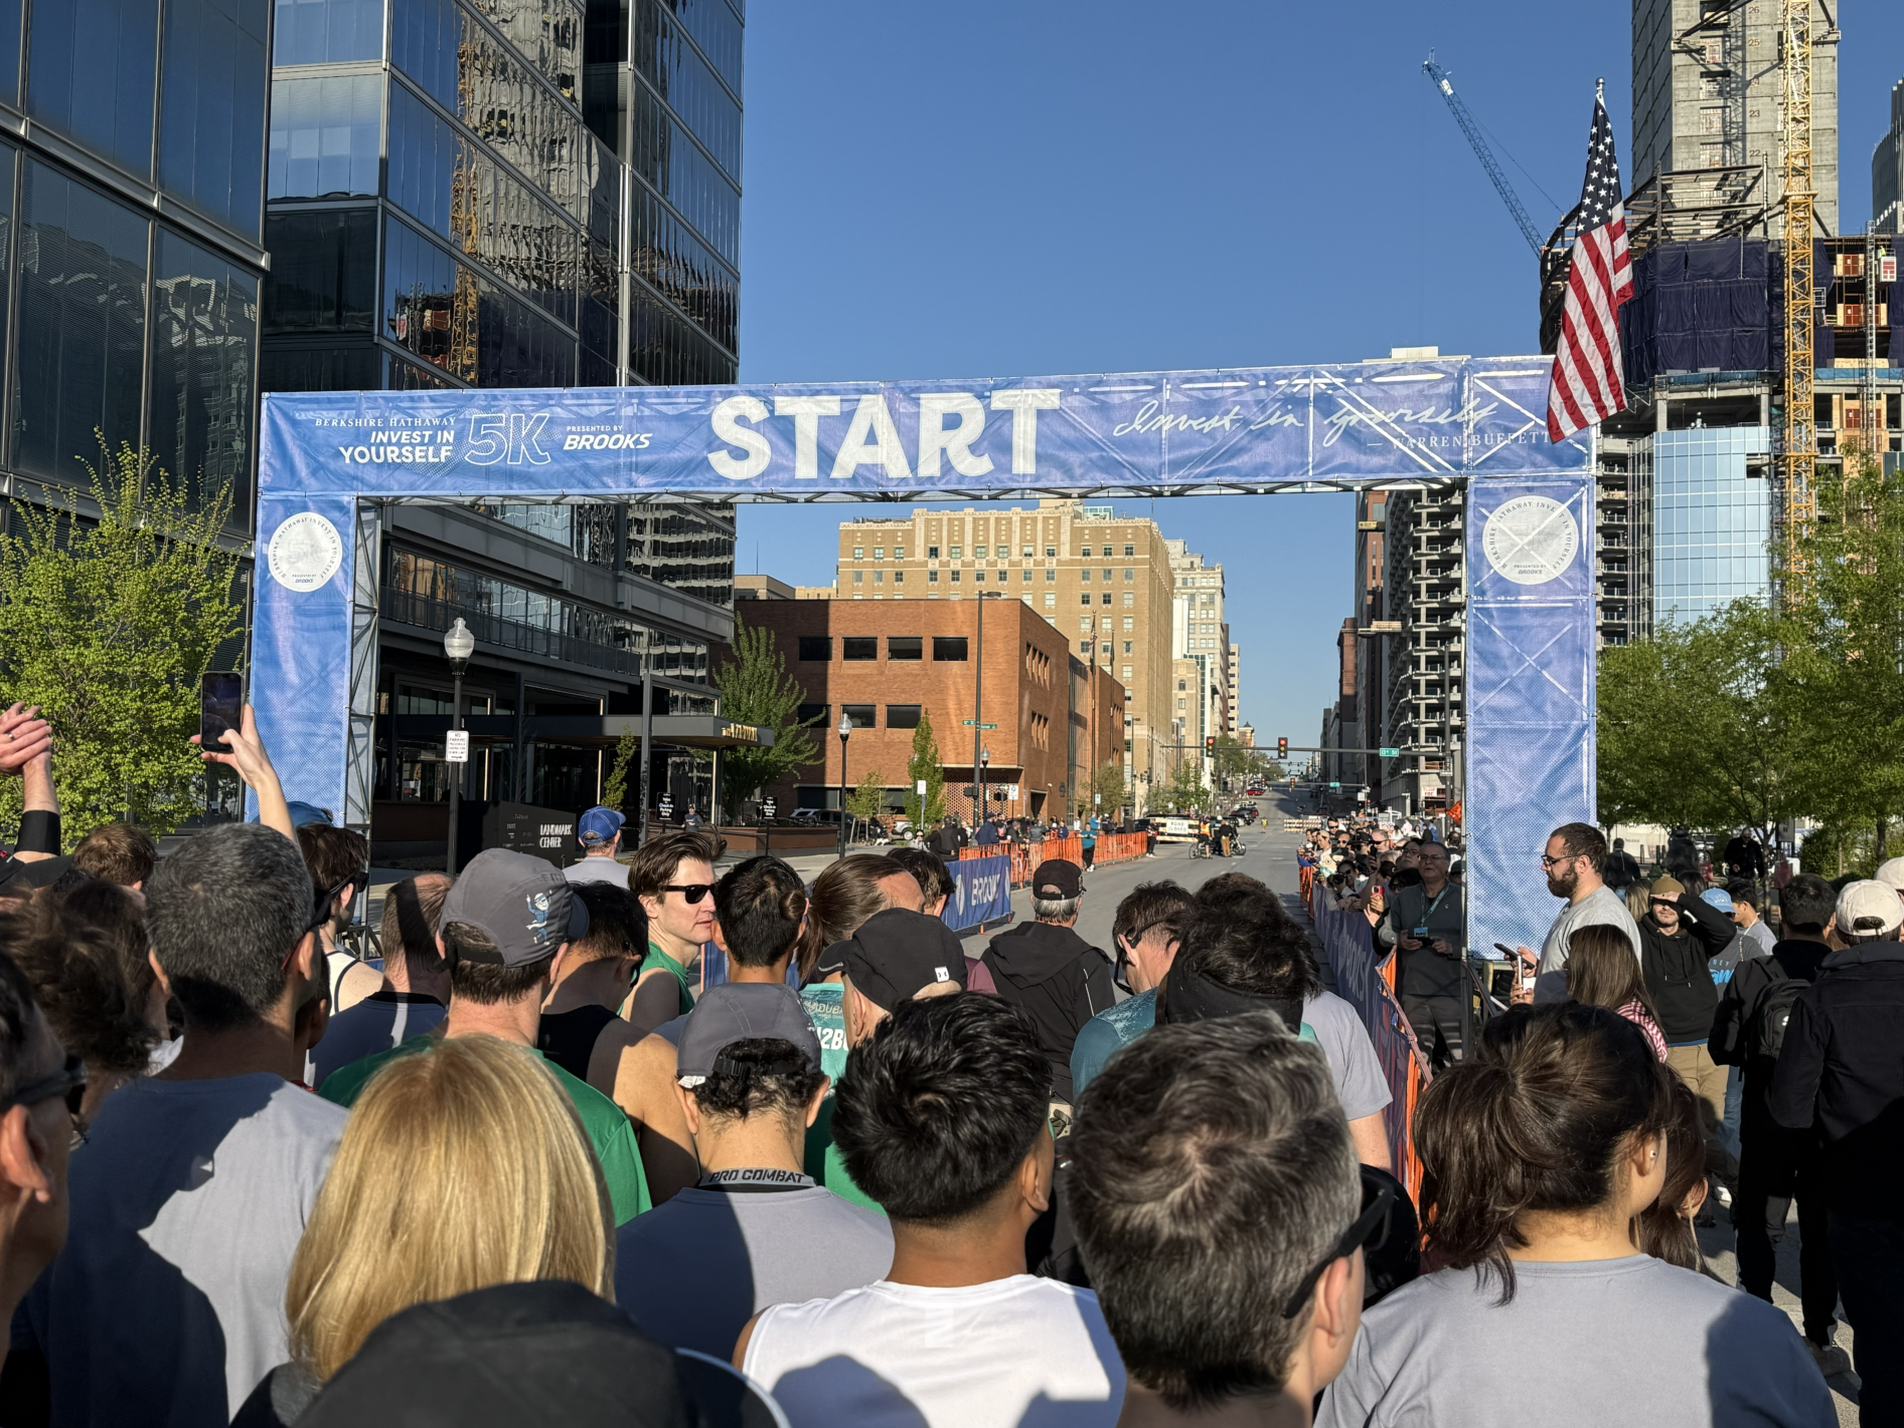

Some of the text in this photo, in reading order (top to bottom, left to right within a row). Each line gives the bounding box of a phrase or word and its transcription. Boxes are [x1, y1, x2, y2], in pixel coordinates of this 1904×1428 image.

[1748, 6, 1760, 15] 26
[1748, 38, 1760, 47] 25
[1749, 109, 1760, 118] 23
[1749, 149, 1761, 158] 22
[315, 417, 456, 427] BERKSHIRE HATHAWAY
[1113, 397, 1499, 447] Invest in yourself
[370, 430, 455, 443] INVEST IN
[464, 413, 552, 466] 5K
[707, 388, 1064, 480] START
[563, 433, 653, 450] BROOKS
[338, 445, 453, 464] YOURSELF
[1536, 501, 1565, 518] INVET
[539, 824, 573, 836] LANDMARK
[539, 836, 562, 848] CENTER
[709, 1169, 805, 1184] PRO COMBAT
